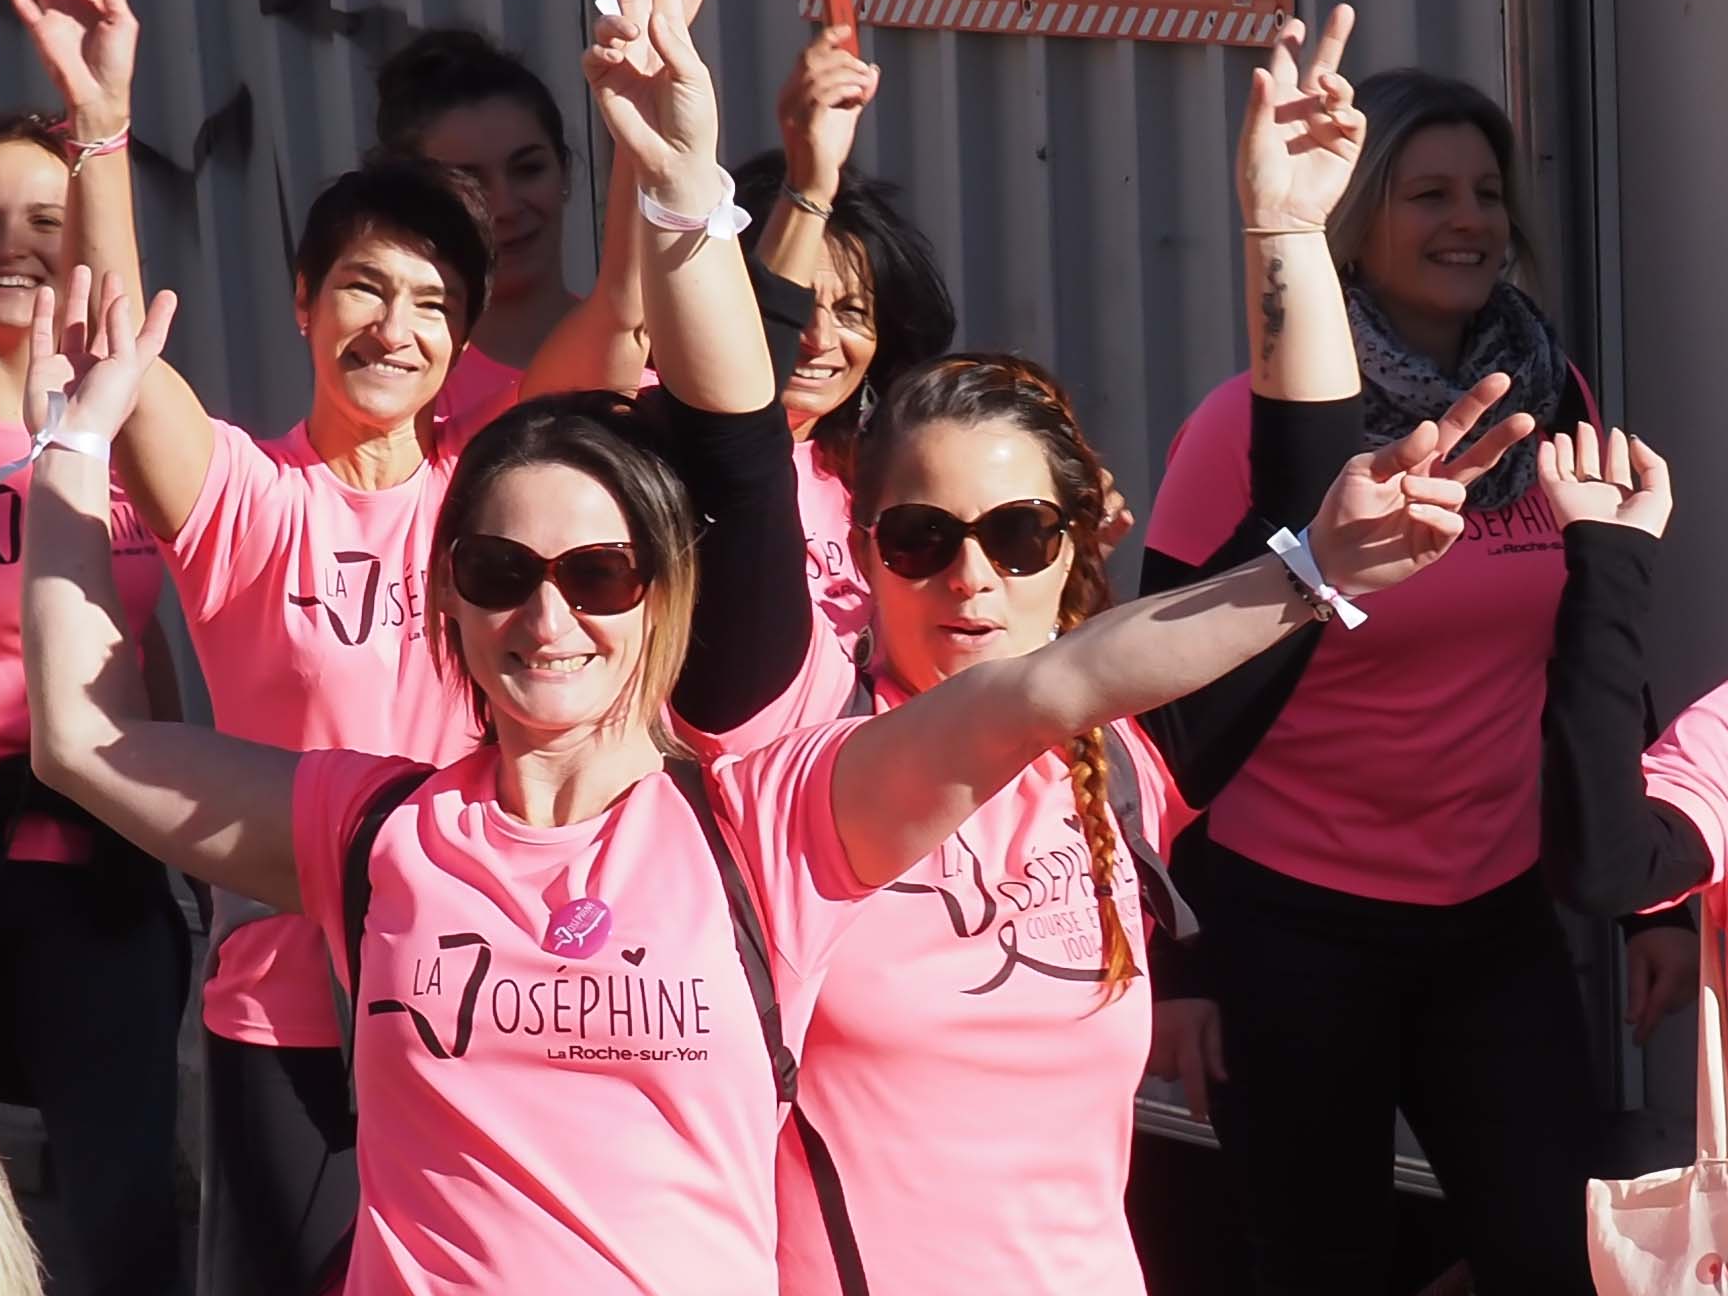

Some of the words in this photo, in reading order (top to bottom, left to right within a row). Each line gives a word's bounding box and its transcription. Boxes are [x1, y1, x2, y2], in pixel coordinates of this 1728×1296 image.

[324, 567, 348, 599] LA
[412, 956, 442, 997] LA
[368, 931, 711, 1059] JOSÉPHINE
[547, 1047, 567, 1061] La
[568, 1044, 709, 1062] Roche-sur-Yon
